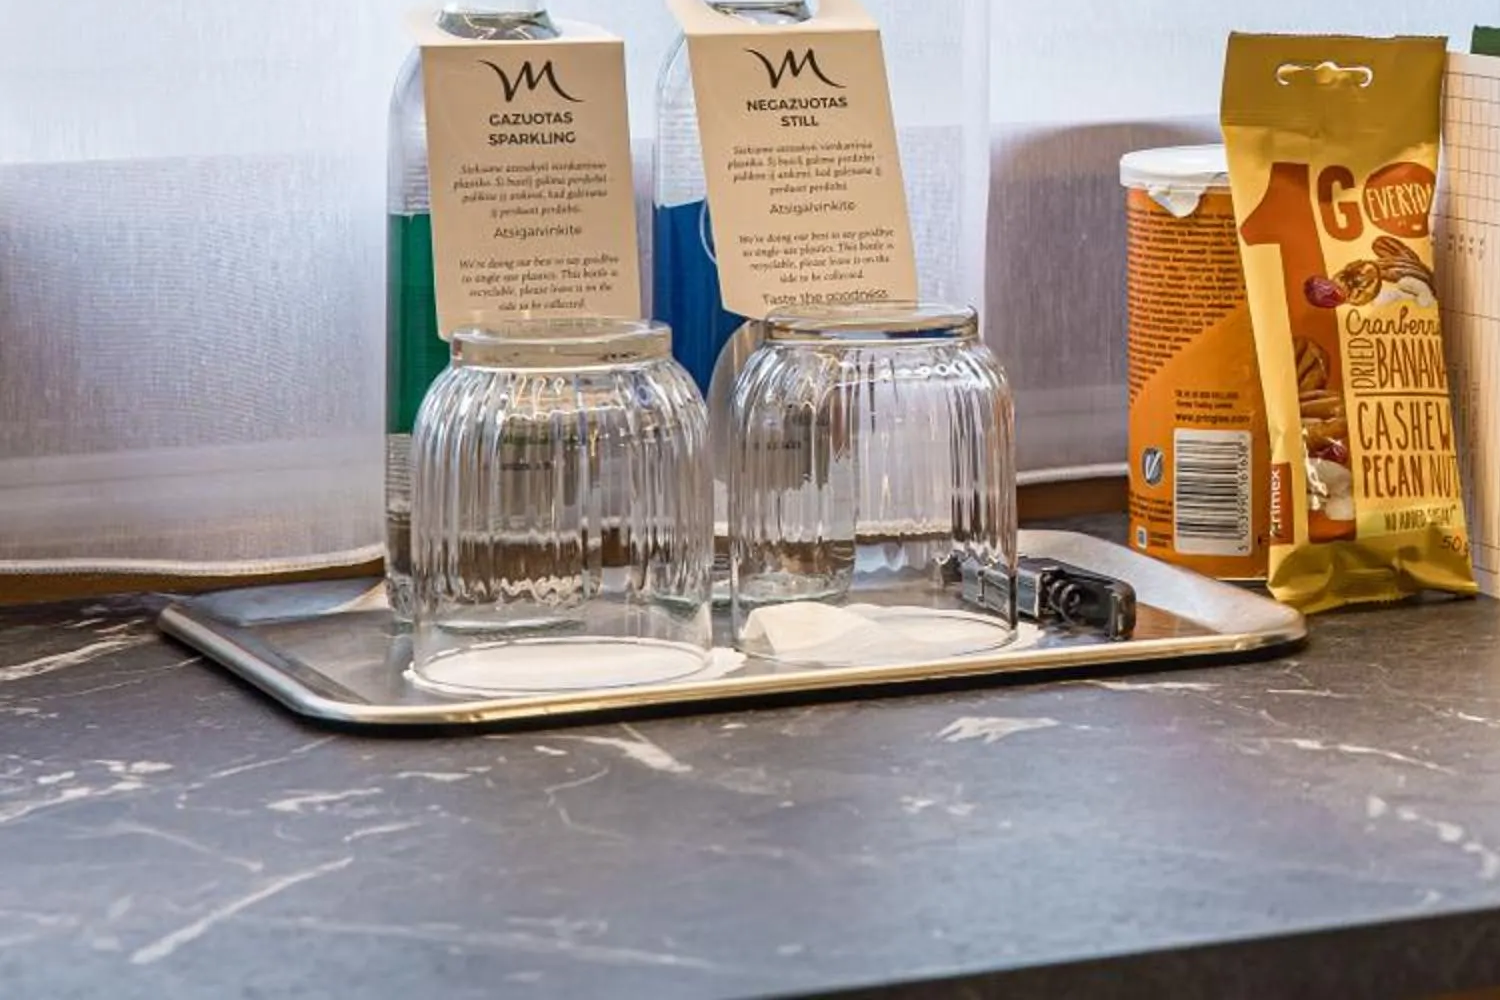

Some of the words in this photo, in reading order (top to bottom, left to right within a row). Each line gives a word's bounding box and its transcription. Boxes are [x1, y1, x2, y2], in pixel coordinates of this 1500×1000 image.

[489, 111, 573, 126] GAZUOTAS
[747, 97, 848, 112] NEGAZUOTAS
[781, 116, 819, 127] STILL
[487, 131, 576, 146] SPARKLING
[1366, 183, 1431, 221] EVERYD
[1346, 305, 1441, 336] Cranberr
[1348, 337, 1376, 388] DRIED
[1358, 401, 1451, 450] CASHEW
[1362, 455, 1424, 498] PECAN
